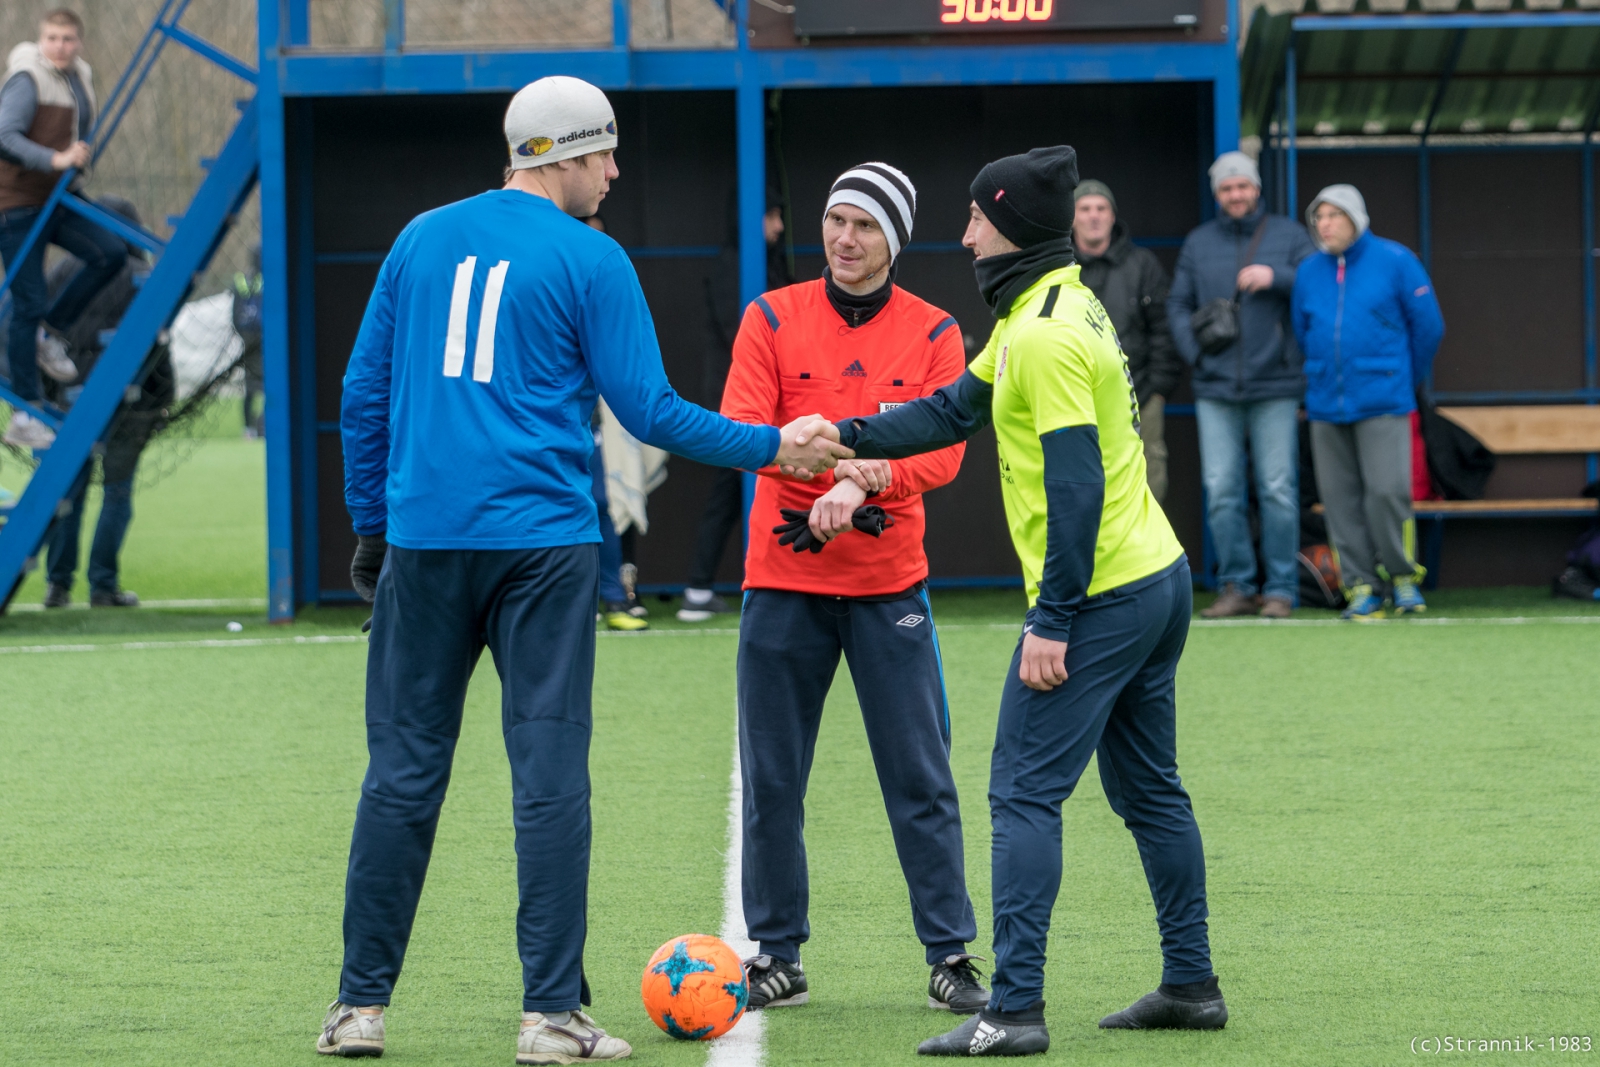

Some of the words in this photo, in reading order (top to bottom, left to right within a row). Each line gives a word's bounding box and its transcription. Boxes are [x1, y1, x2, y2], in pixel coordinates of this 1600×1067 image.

[557, 127, 603, 145] adidas
[442, 255, 511, 384] 11
[969, 1028, 1007, 1055] adidas
